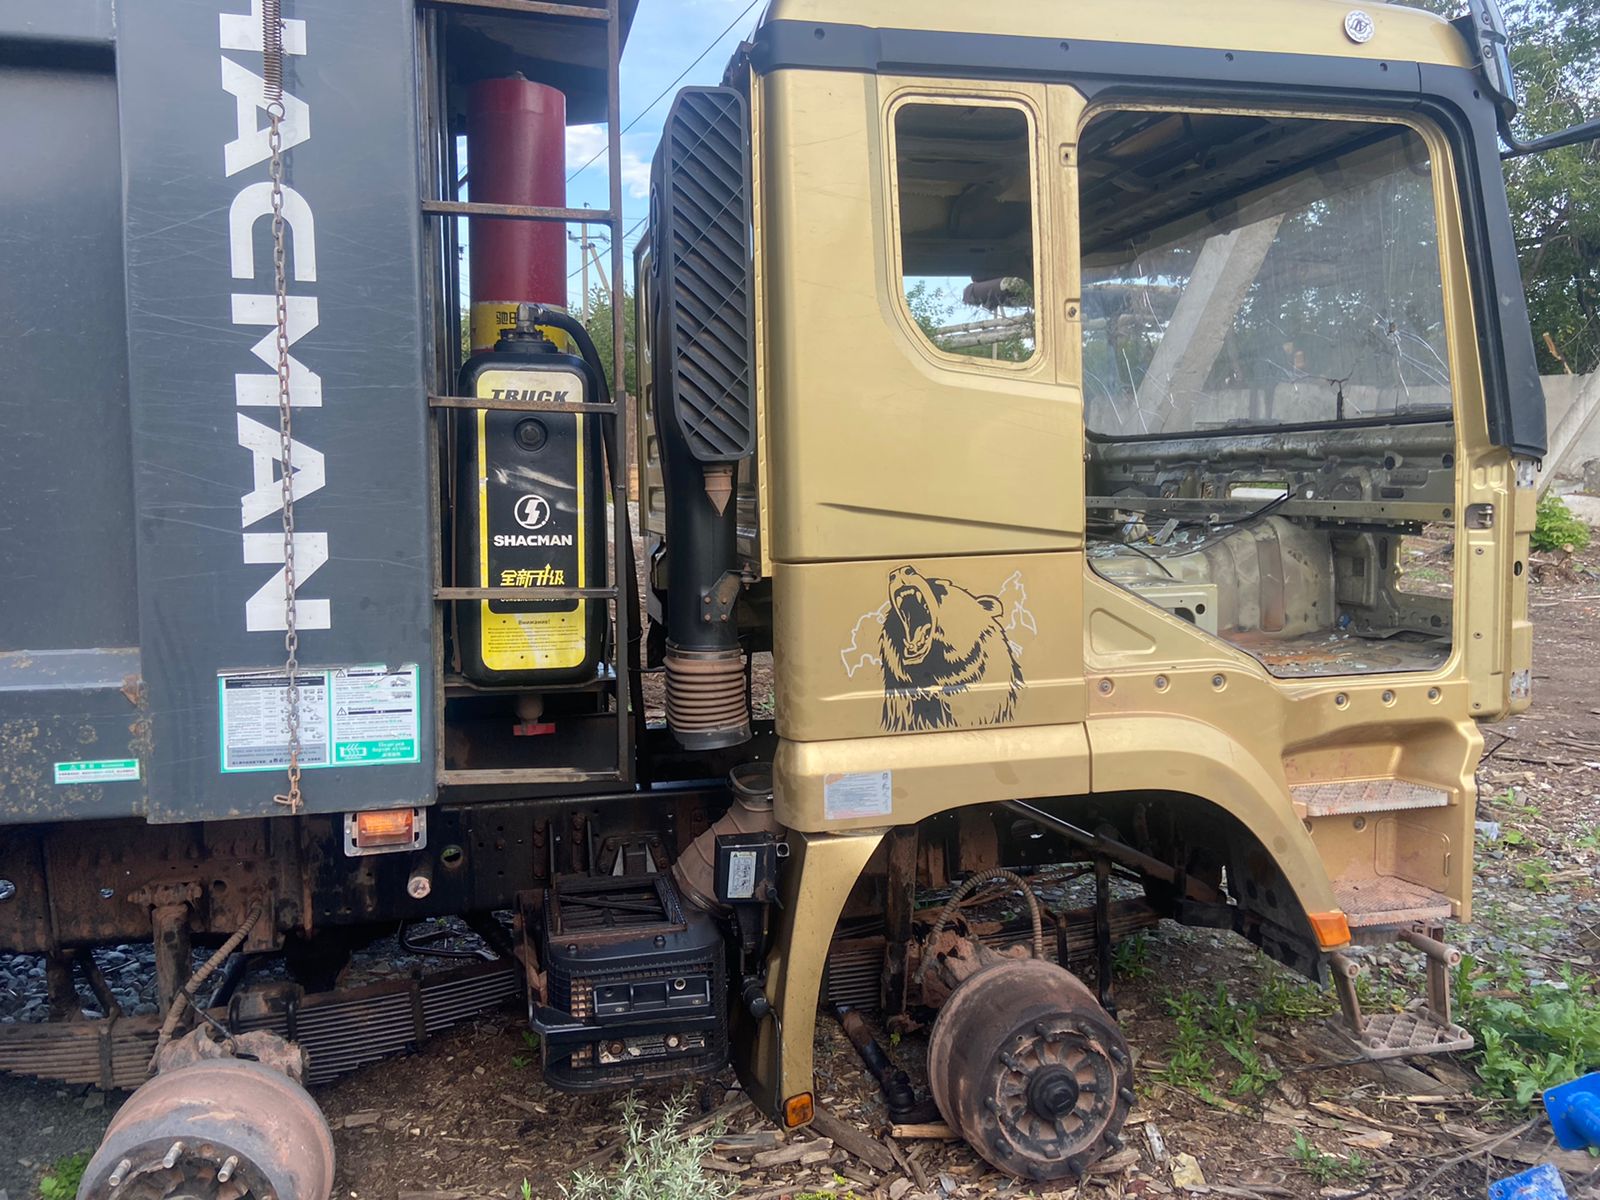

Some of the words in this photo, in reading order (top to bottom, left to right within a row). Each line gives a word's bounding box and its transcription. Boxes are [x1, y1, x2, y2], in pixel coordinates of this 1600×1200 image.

[491, 389, 569, 402] TRUCK
[493, 534, 573, 547] SHACMAN
[500, 563, 565, 588] 全新升级
